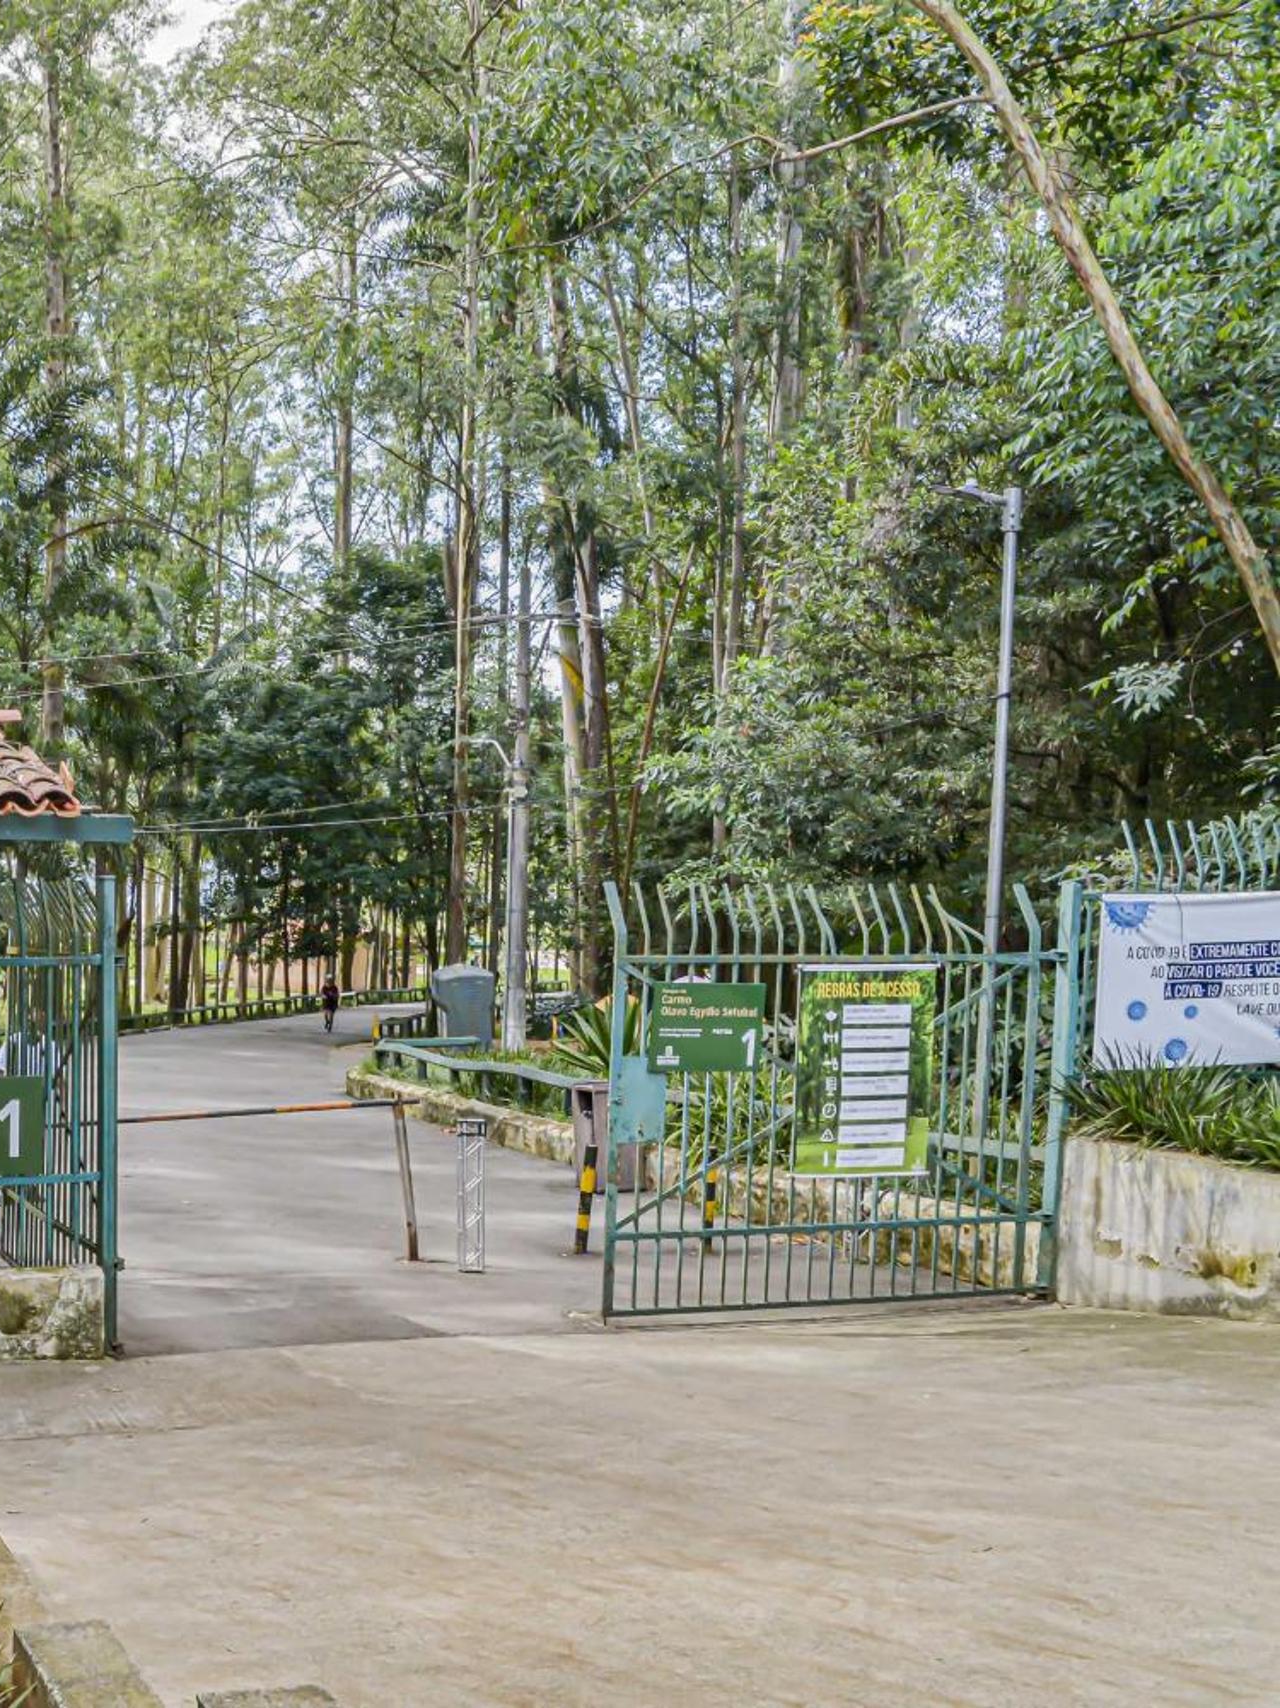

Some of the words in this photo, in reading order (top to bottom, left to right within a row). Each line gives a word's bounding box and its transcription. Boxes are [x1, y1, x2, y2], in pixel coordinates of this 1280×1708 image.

[1191, 943, 1270, 958] EXTREMAMENTE
[1150, 965, 1165, 979] AO
[1168, 965, 1204, 979] VISITAR
[1206, 964, 1214, 978] O
[1215, 963, 1253, 977] PARQUE
[817, 982, 860, 998] REGRAS
[863, 982, 876, 998] DE
[878, 981, 920, 998] ACESSO
[1174, 983, 1221, 998] COVID-19
[1223, 983, 1270, 997] RESPEITE
[661, 994, 692, 1005] Carmo
[661, 1006, 688, 1017] Olavo
[690, 1006, 720, 1019] Egydio
[741, 1028, 757, 1068] 1
